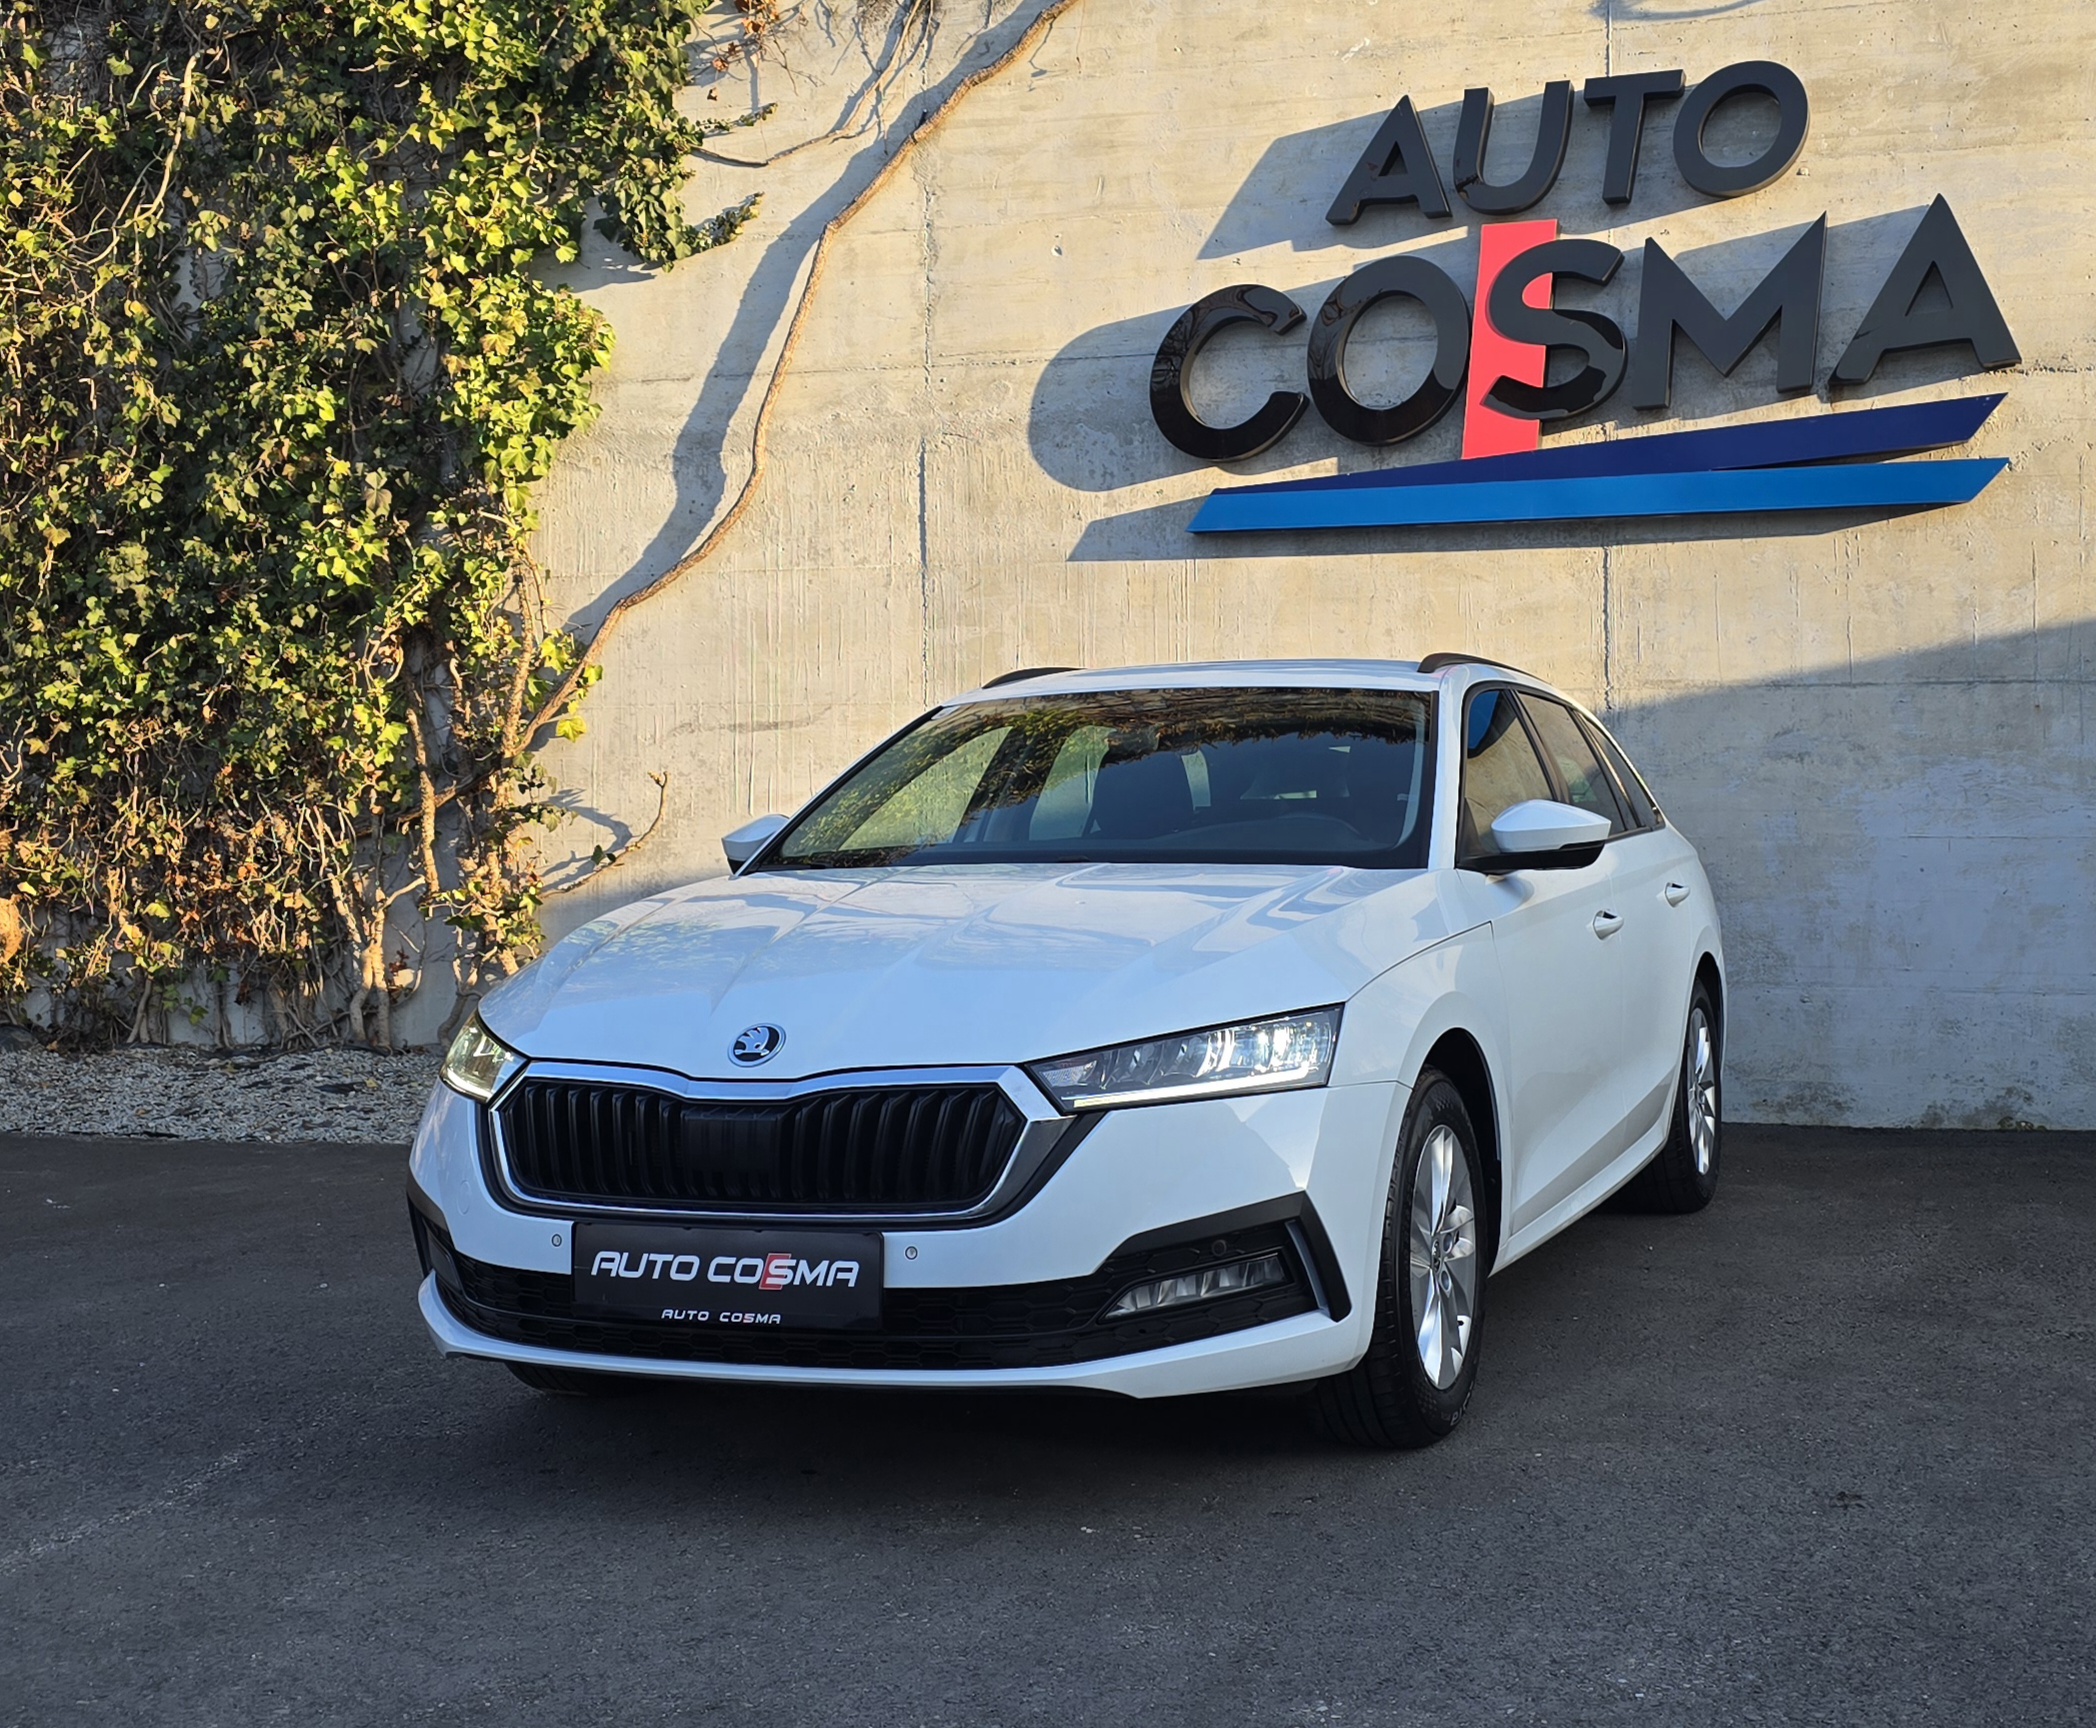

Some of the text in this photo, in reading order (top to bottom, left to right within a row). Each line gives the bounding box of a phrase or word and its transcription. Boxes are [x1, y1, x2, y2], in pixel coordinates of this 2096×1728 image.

[1326, 60, 1811, 226] AUTO
[1150, 194, 2022, 461] COSMA
[591, 1251, 860, 1288] AUTO COSMA
[661, 1309, 781, 1324] AUTO COSMA
